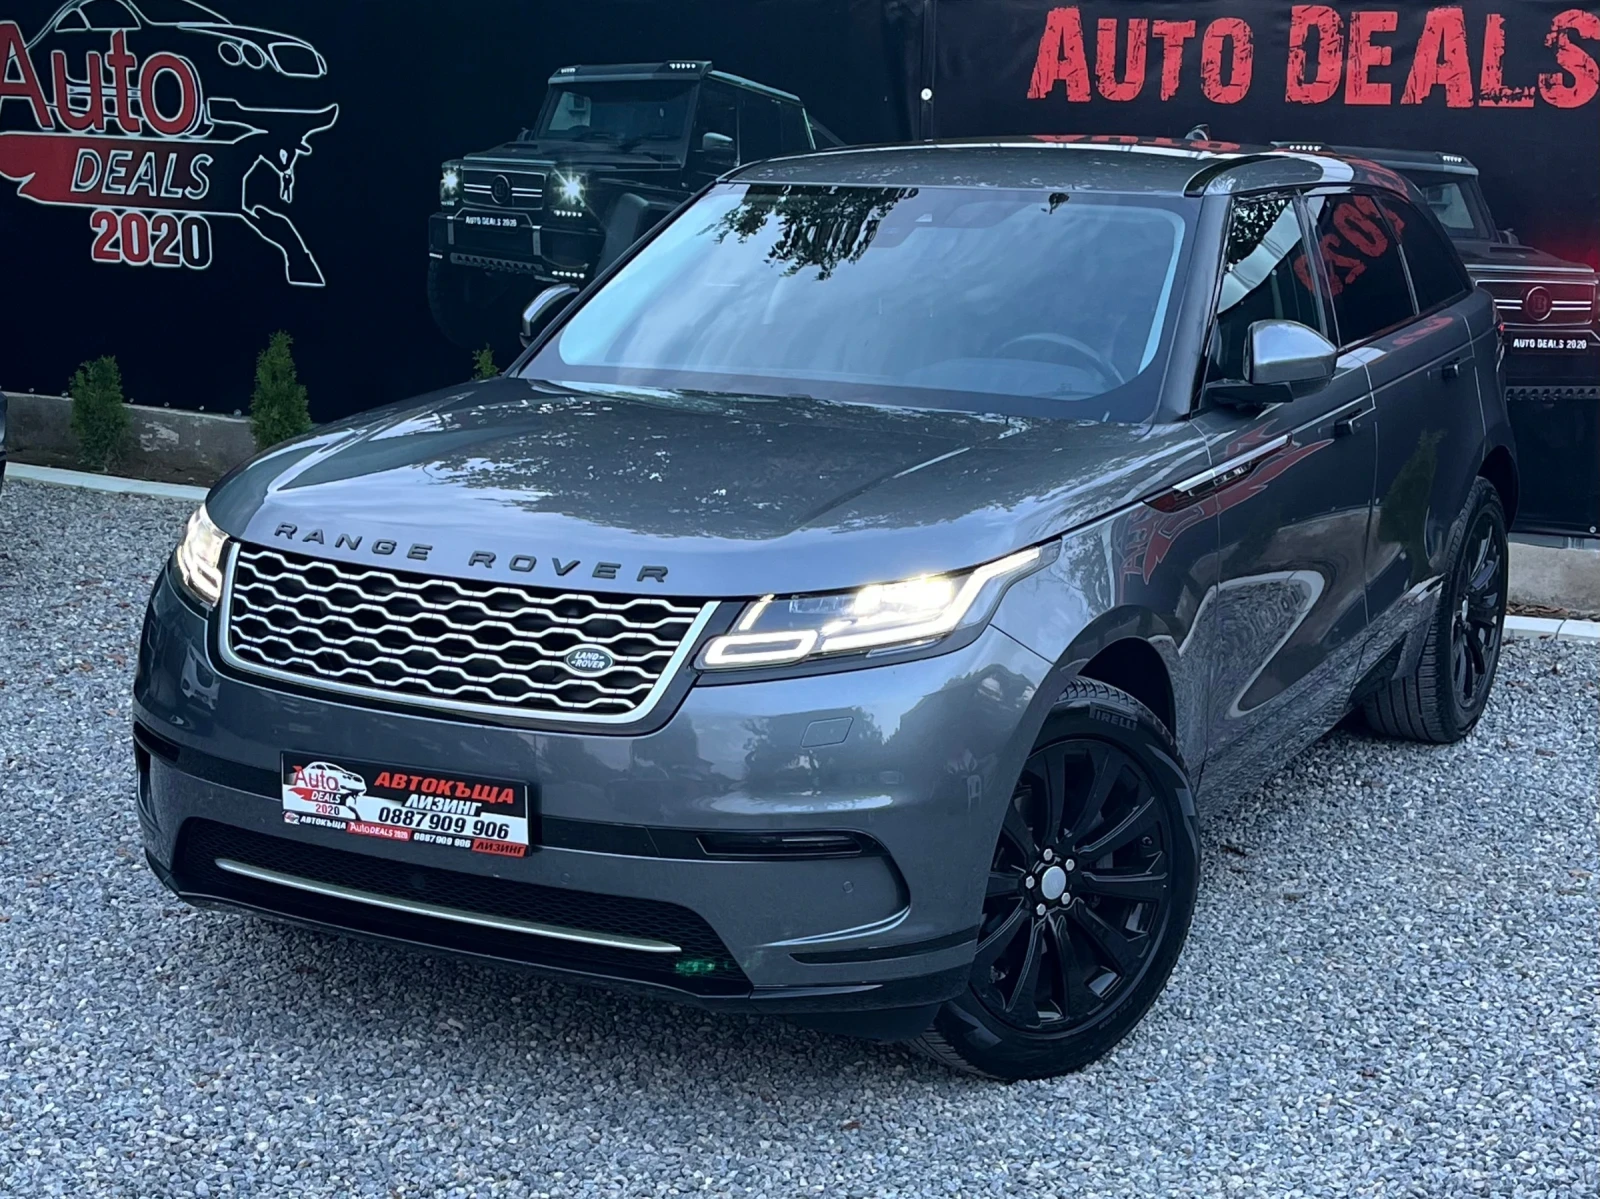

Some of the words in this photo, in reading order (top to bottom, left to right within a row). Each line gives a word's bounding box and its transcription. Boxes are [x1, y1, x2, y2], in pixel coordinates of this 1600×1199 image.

[0, 20, 200, 135] Auto
[70, 148, 214, 200] DEALS
[90, 209, 213, 269] 2020
[1513, 338, 1535, 348] AUTO
[1537, 338, 1564, 349] DEALS
[1566, 339, 1587, 349] 2020
[274, 521, 433, 560] RANGE
[468, 550, 670, 584] ROVER
[293, 765, 340, 791] Auto
[373, 771, 515, 805] АВТОКЪЩА
[311, 791, 341, 804] DEALS
[315, 803, 340, 816] 2020
[404, 794, 483, 816] ЛИЗИНГ
[300, 815, 347, 830] АВТОКЪЩА
[377, 806, 427, 834] 0887
[428, 815, 467, 834] 909
[471, 820, 511, 840] 906
[475, 843, 526, 856] ЛИЗИНГ
